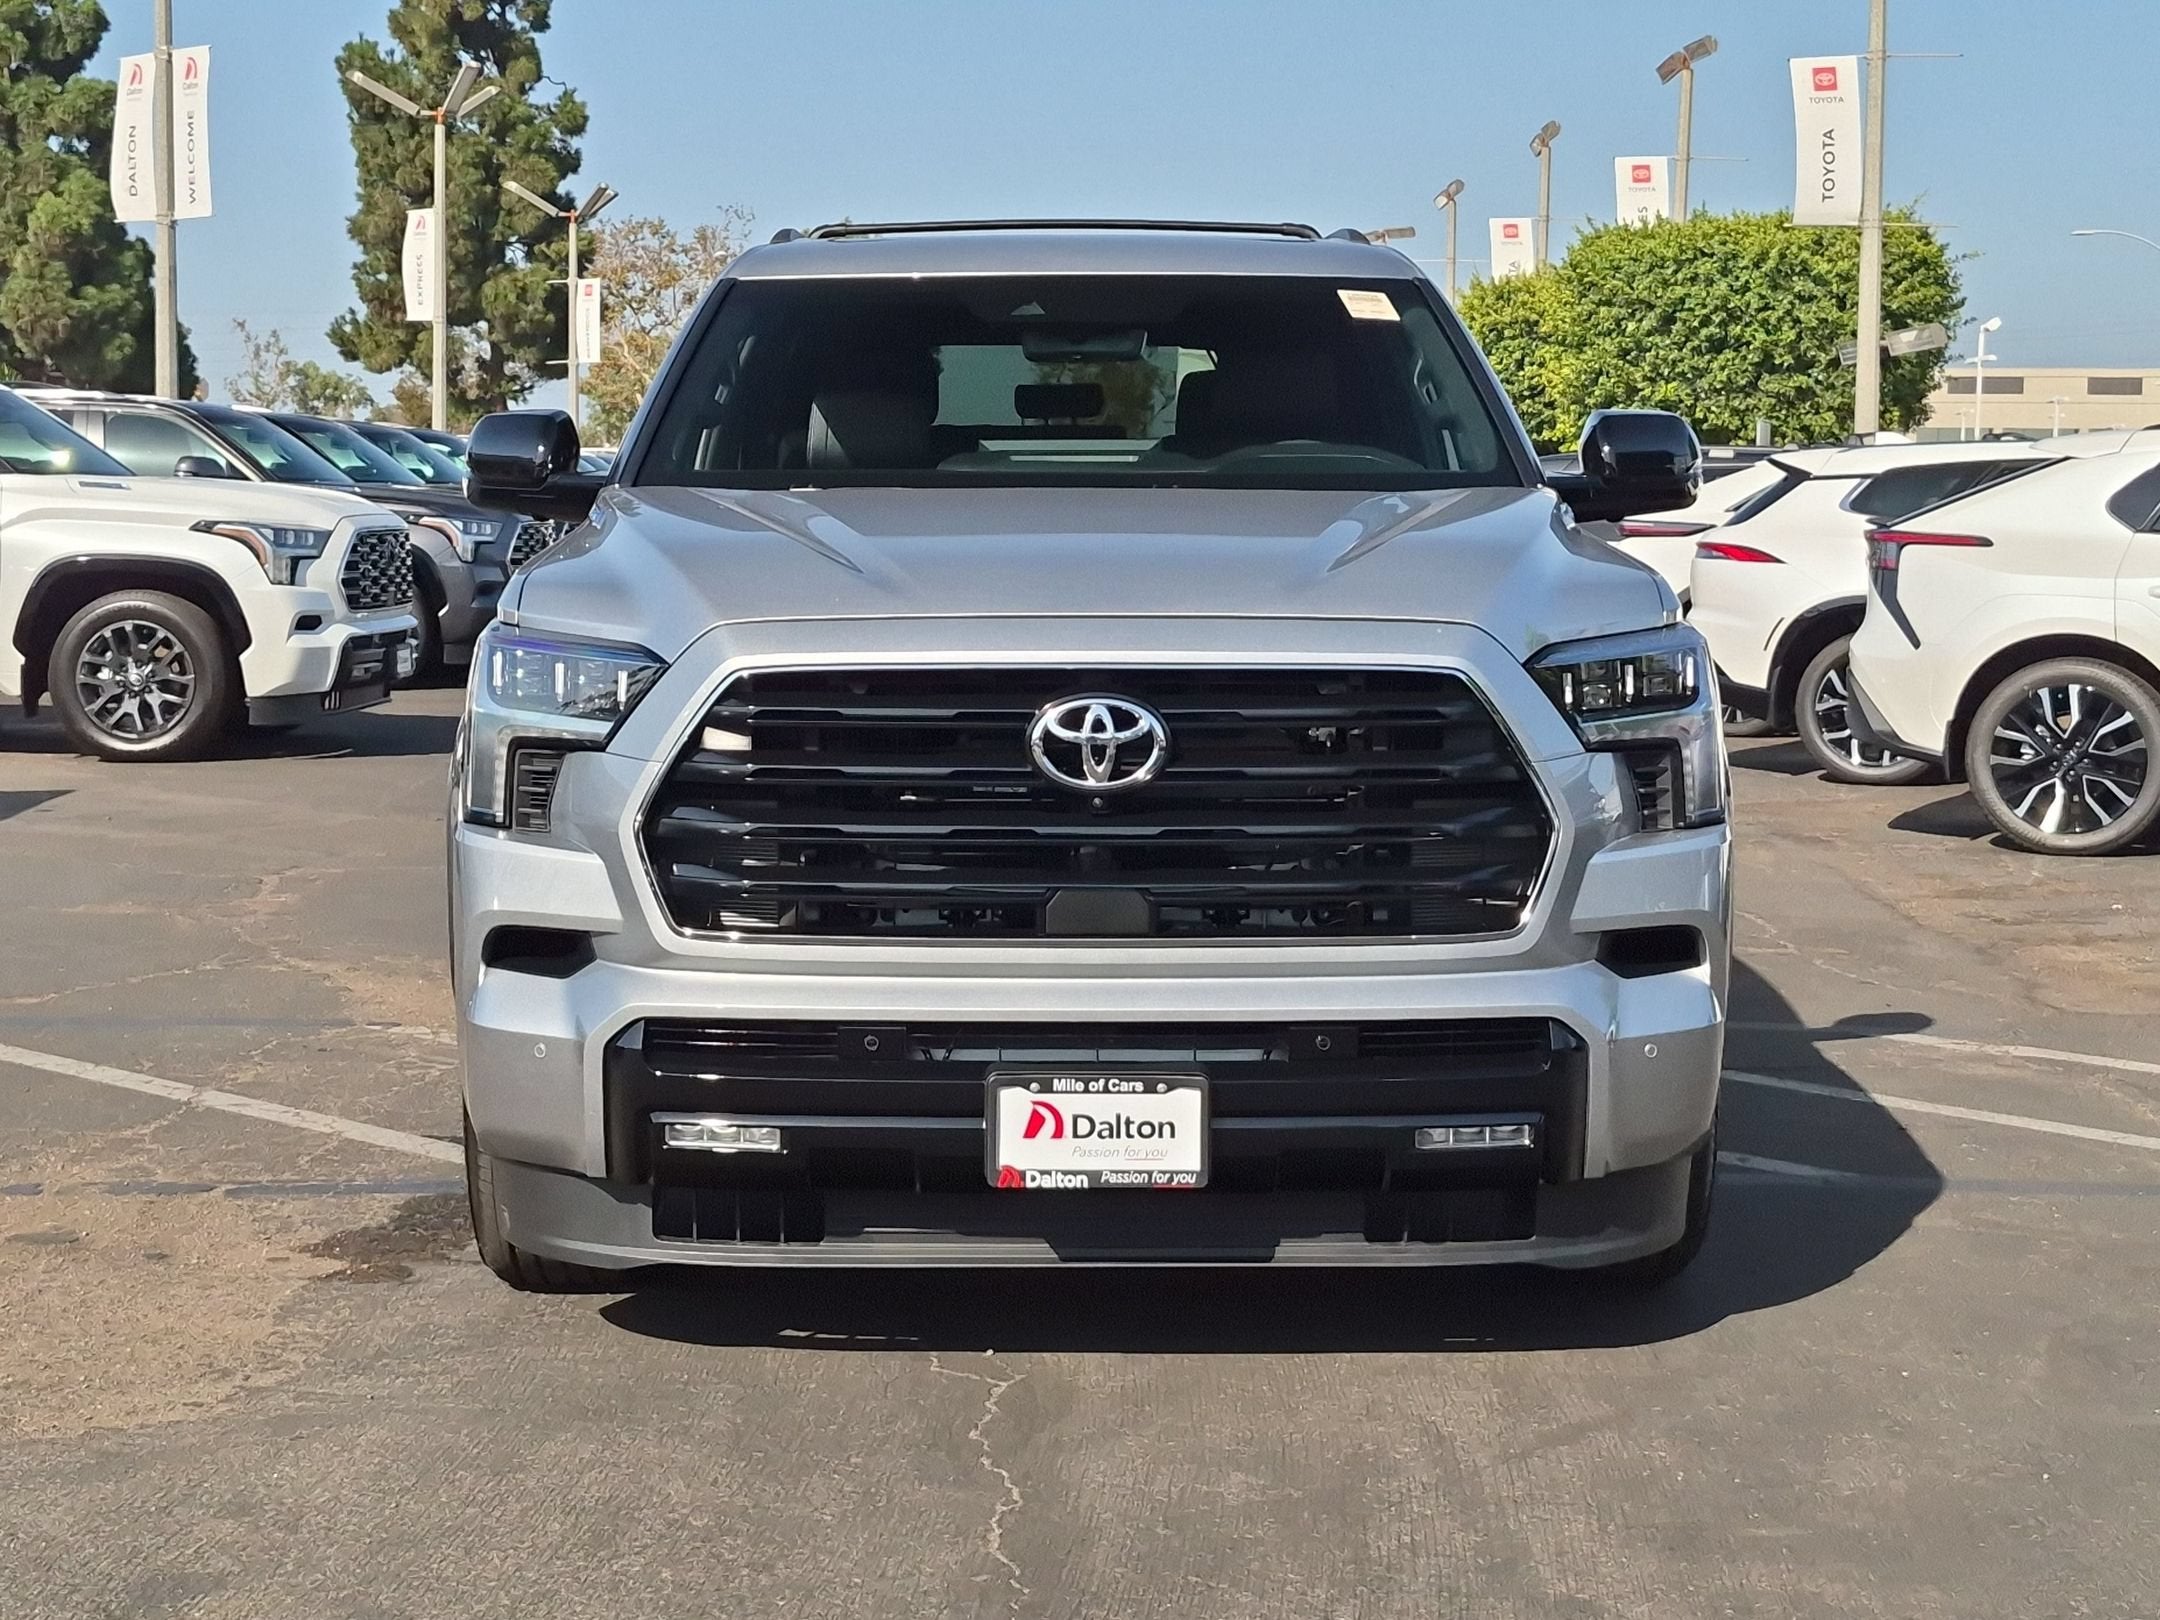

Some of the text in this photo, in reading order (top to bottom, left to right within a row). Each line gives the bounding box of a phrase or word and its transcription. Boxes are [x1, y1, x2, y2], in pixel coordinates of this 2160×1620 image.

[1808, 95, 1845, 105] TOYOTA
[127, 125, 138, 197] DALTON
[186, 110, 197, 205] WELCOME
[1822, 127, 1836, 203] TOYOTA
[1052, 1078, 1145, 1093] Mile of Cars
[1071, 1113, 1176, 1139] Dalton
[1071, 1145, 1168, 1160] Passion for you
[1025, 1169, 1089, 1189] Dalton
[1100, 1170, 1197, 1186] Passion for you
